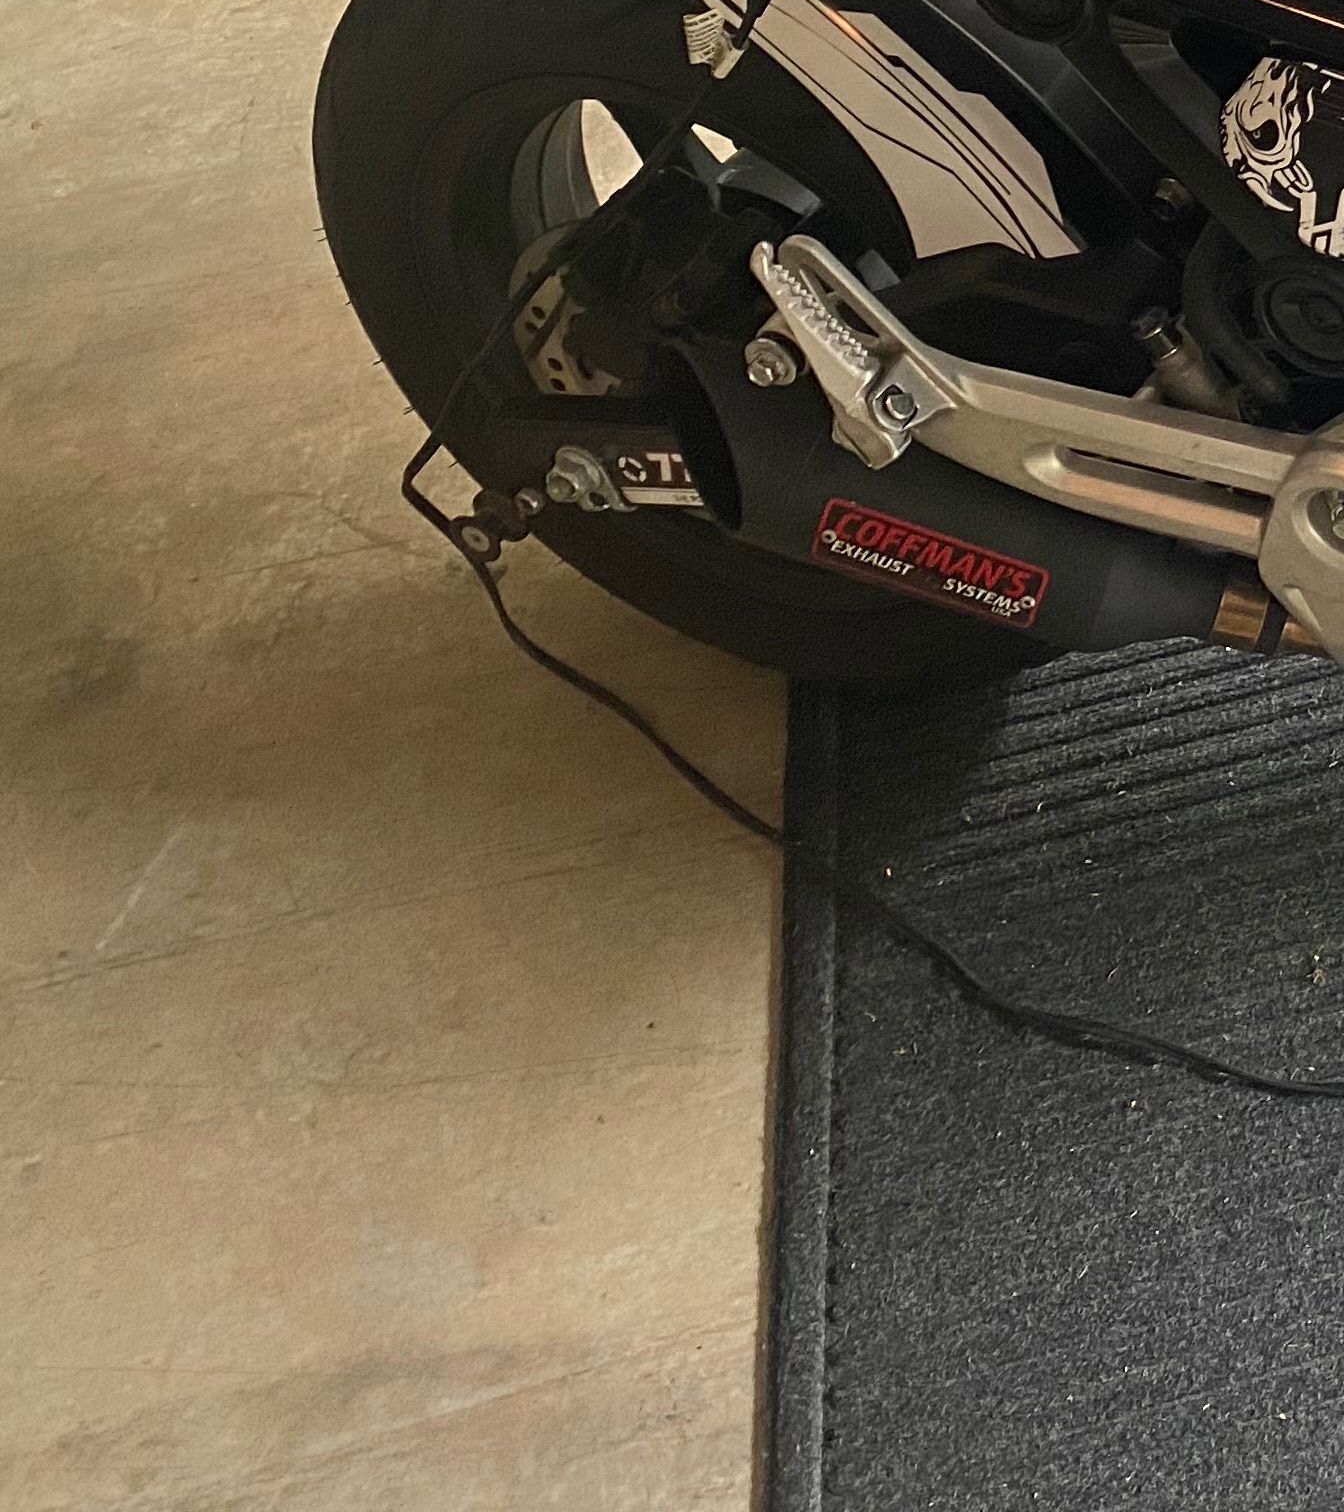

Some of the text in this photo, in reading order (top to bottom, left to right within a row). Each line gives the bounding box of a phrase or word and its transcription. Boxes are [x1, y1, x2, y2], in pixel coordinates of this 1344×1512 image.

[830, 540, 1021, 613] EXHAUST SYSTEMS
[834, 511, 1031, 598] COFFMAN'S
